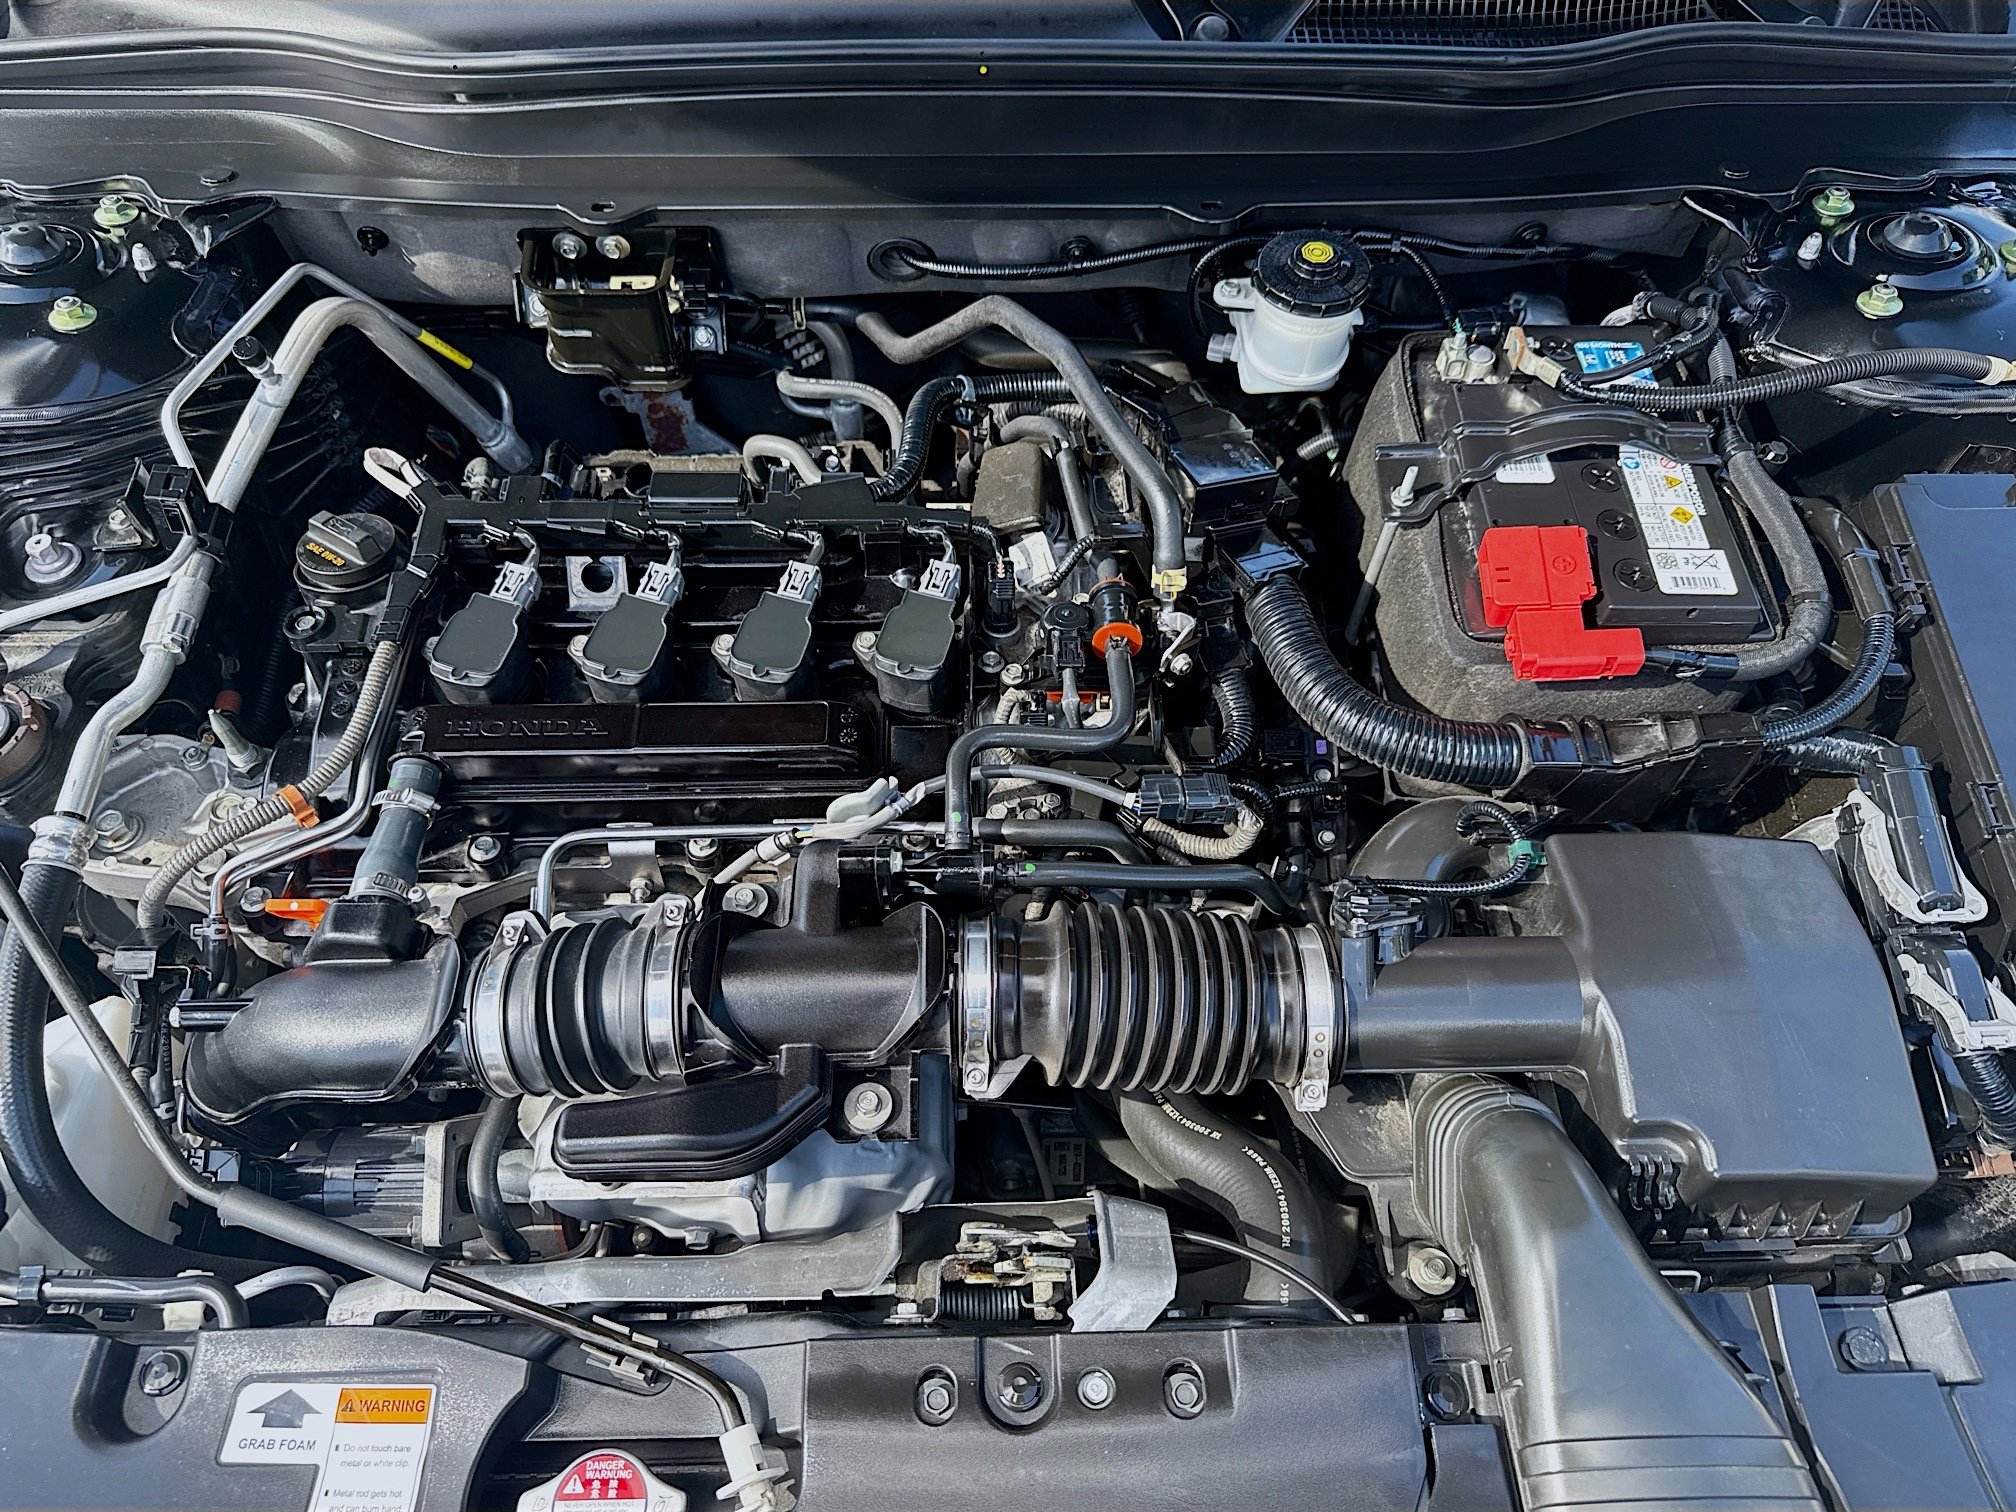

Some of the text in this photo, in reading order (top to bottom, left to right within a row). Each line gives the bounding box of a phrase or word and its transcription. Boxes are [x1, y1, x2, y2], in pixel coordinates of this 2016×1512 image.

[1681, 463, 1707, 516] NGER/POISON
[306, 542, 324, 554] SAE
[321, 550, 345, 566] 0W-20
[444, 718, 608, 736] HONDA
[1280, 1283, 1289, 1306] 66<
[360, 1400, 426, 1412] WARNING
[238, 1438, 316, 1450] GRAB FOAM
[586, 1461, 624, 1470] DANGER
[586, 1470, 633, 1479] WARNUNG
[371, 1491, 387, 1499] gets
